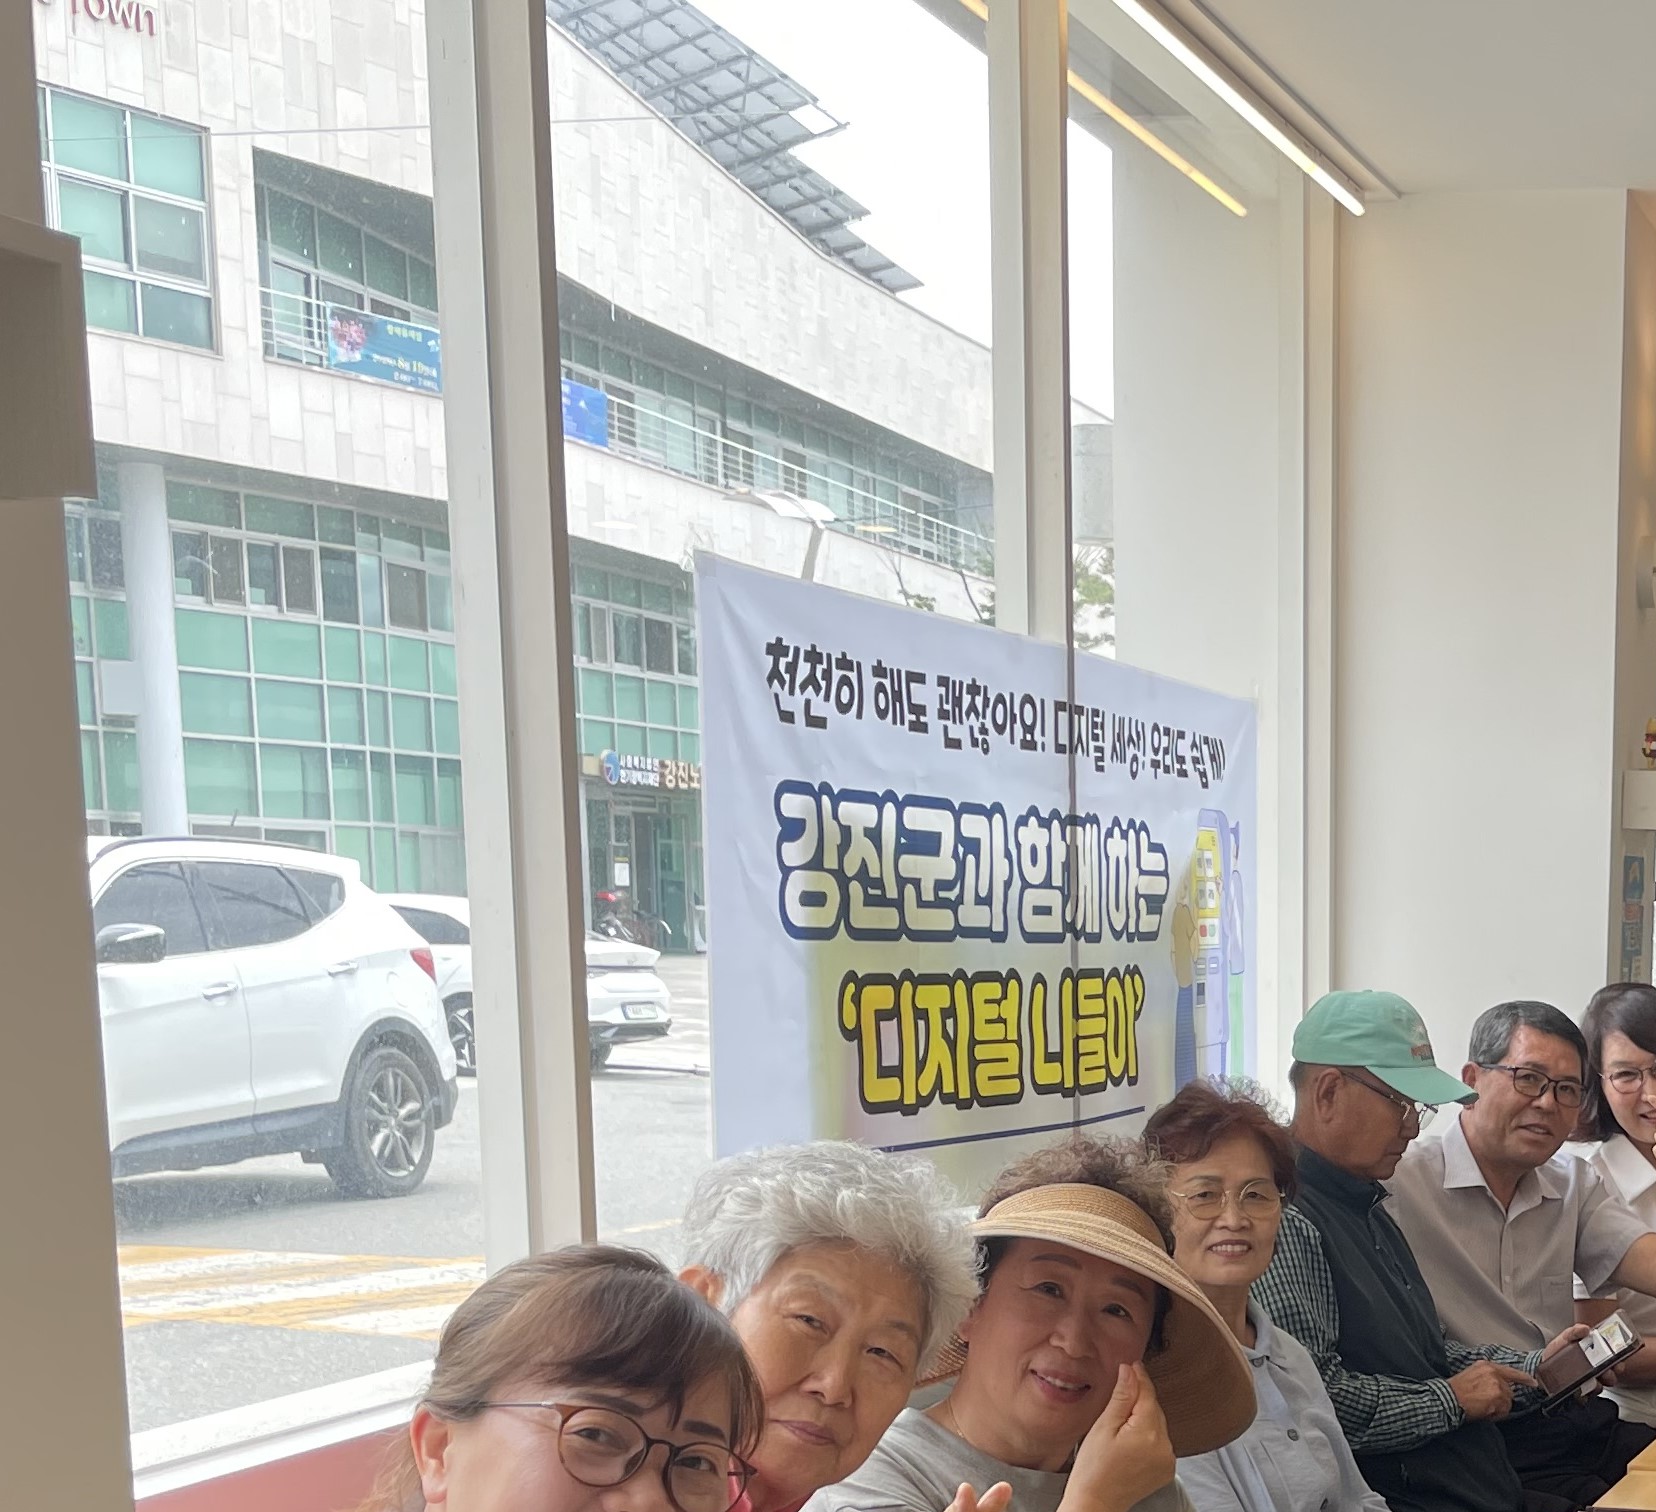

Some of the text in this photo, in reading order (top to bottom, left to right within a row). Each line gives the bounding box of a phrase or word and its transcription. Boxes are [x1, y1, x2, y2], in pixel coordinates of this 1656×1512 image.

[765, 636, 1226, 789] 천천히 해도 괜찮아요! 디지털 세상! 우리도 쉽게!
[775, 779, 1013, 943] 강진군과
